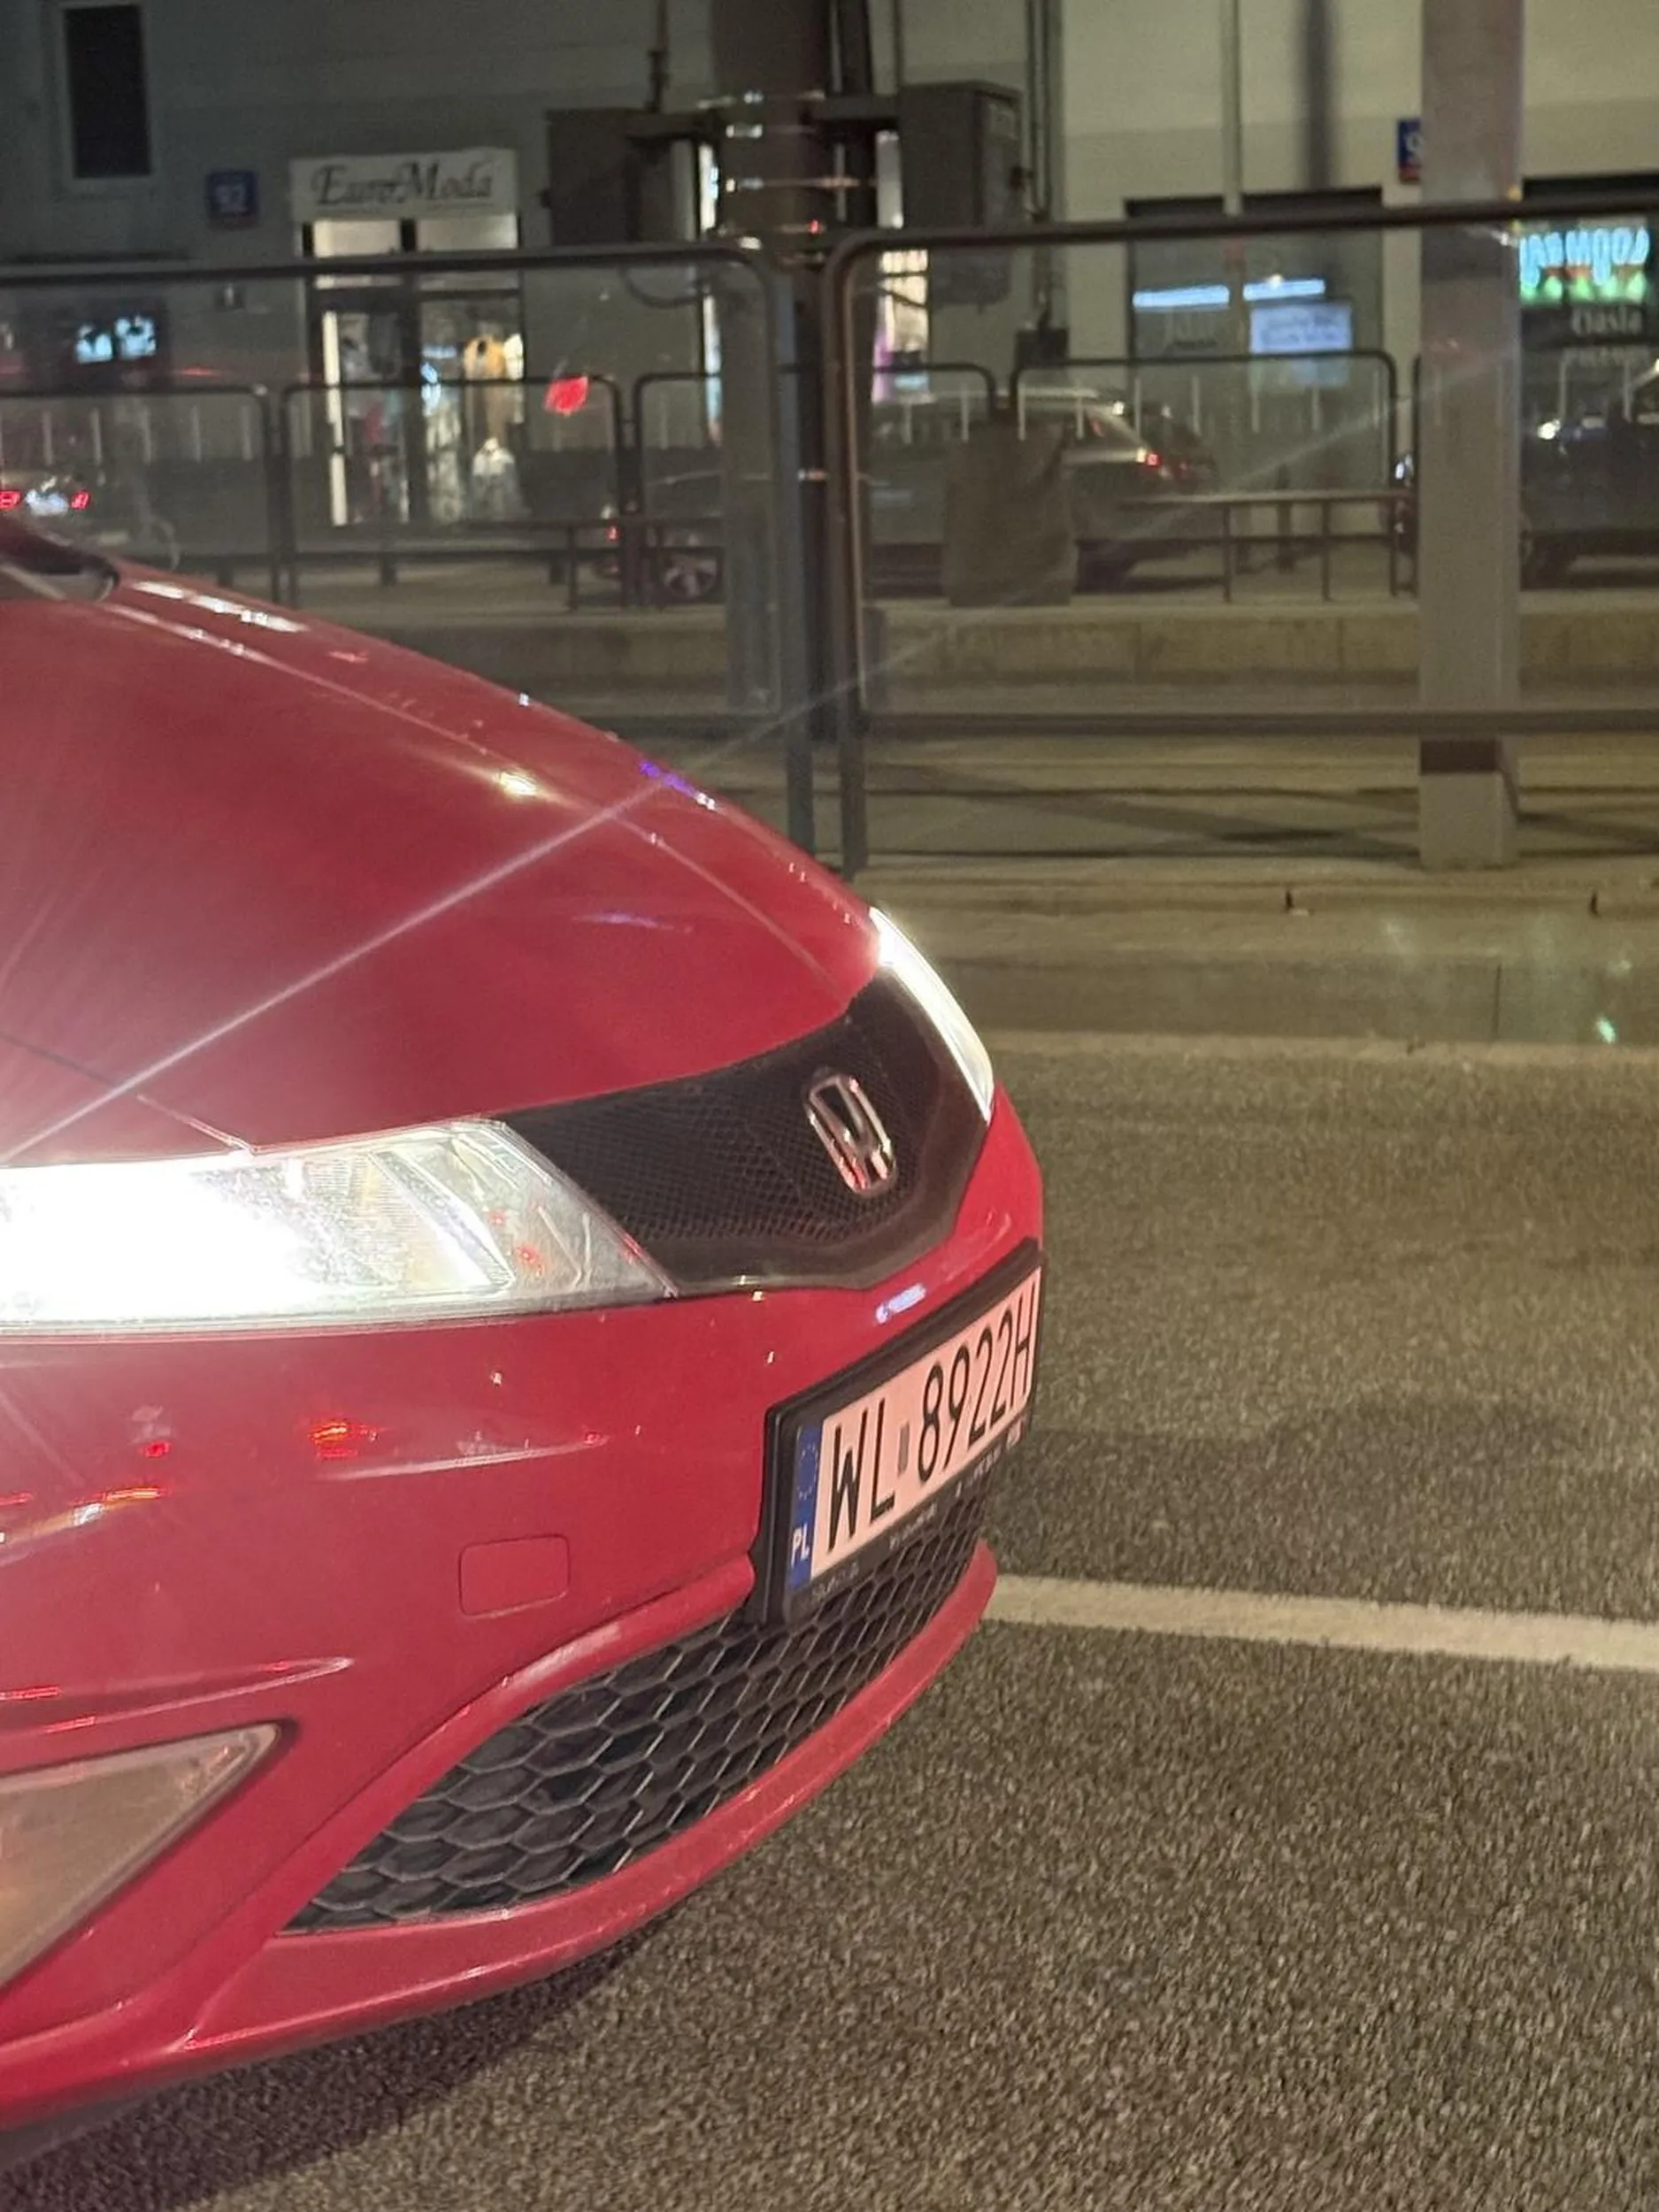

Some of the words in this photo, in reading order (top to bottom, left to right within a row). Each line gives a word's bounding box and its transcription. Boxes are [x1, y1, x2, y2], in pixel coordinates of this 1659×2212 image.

[826, 1398, 896, 1555] WL
[918, 1280, 1036, 1484] 8922H
[790, 1528, 811, 1565] PL
